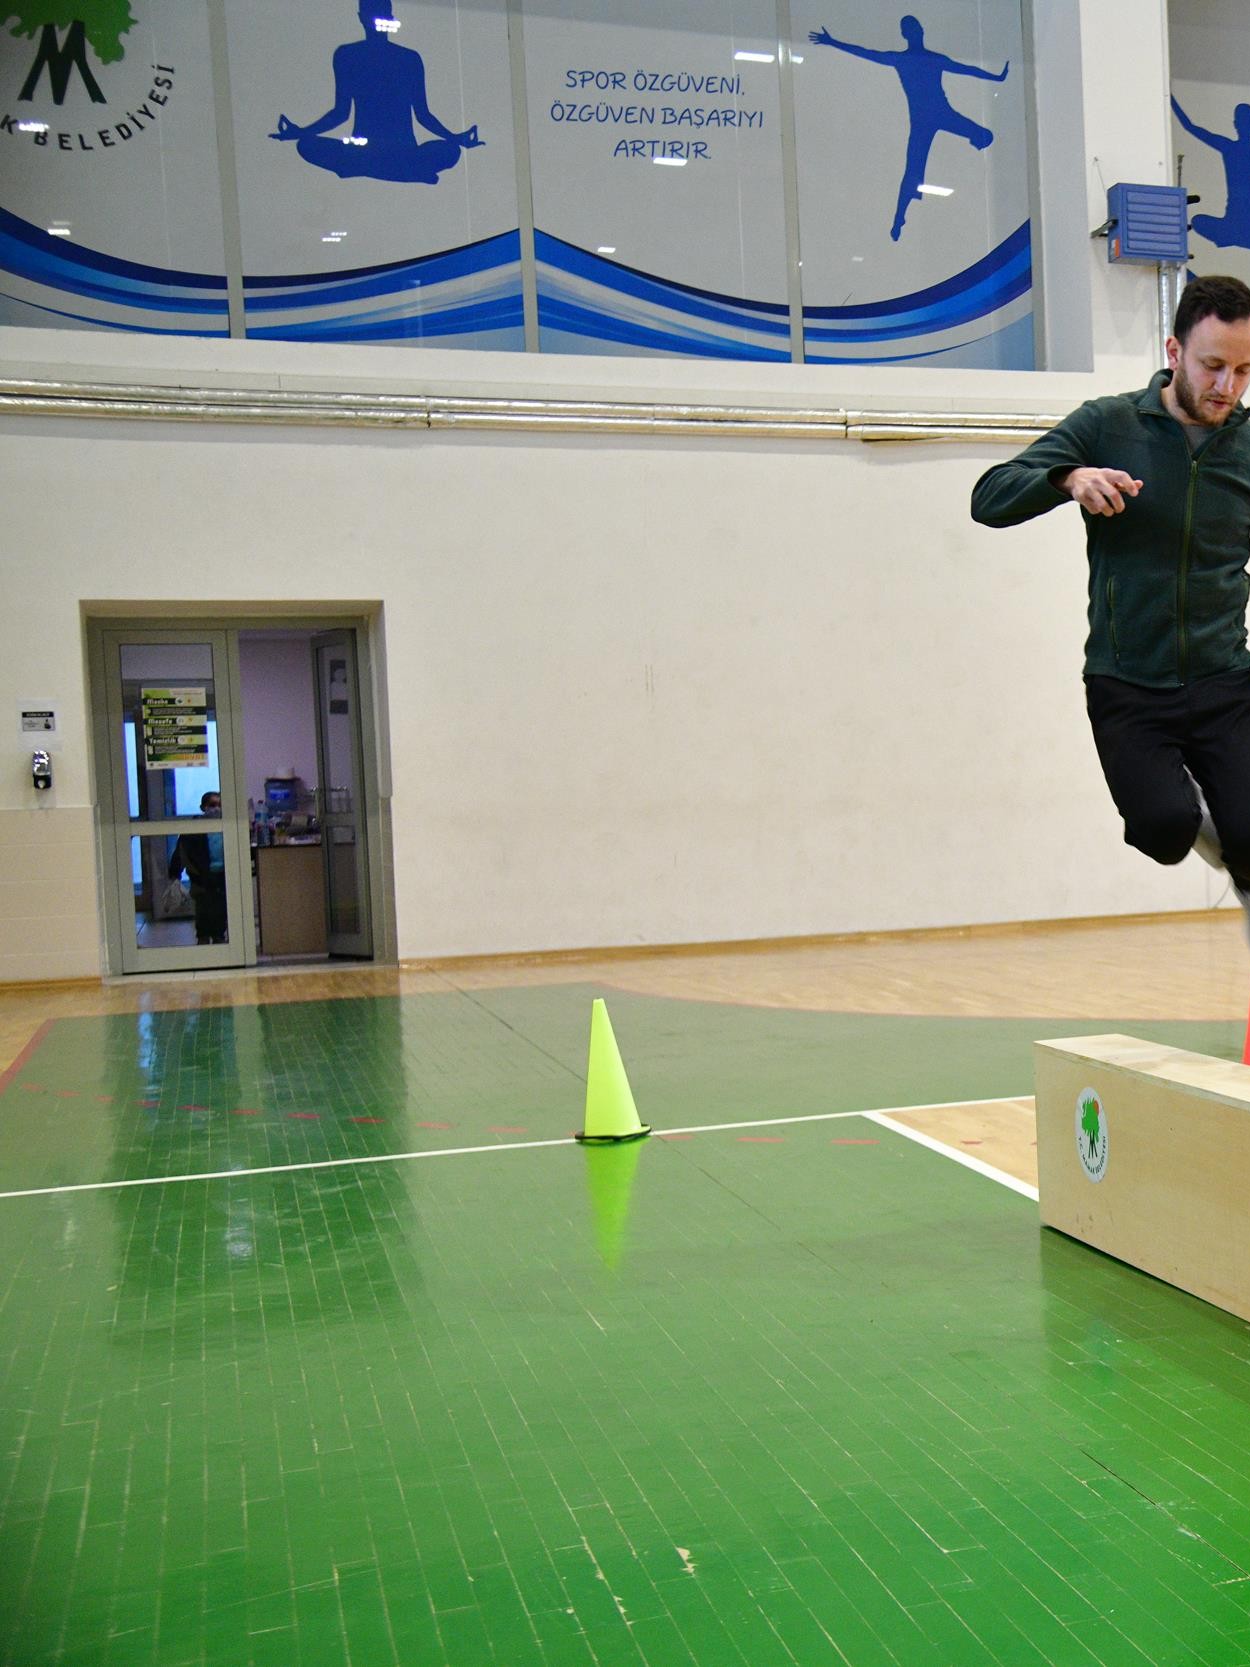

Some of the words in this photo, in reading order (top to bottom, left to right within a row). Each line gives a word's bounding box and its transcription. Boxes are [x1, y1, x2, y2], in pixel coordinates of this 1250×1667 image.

[565, 70, 627, 90] SPOR
[550, 100, 655, 125] ÖZGÜVEN
[661, 107, 764, 129] BAŞARIYI
